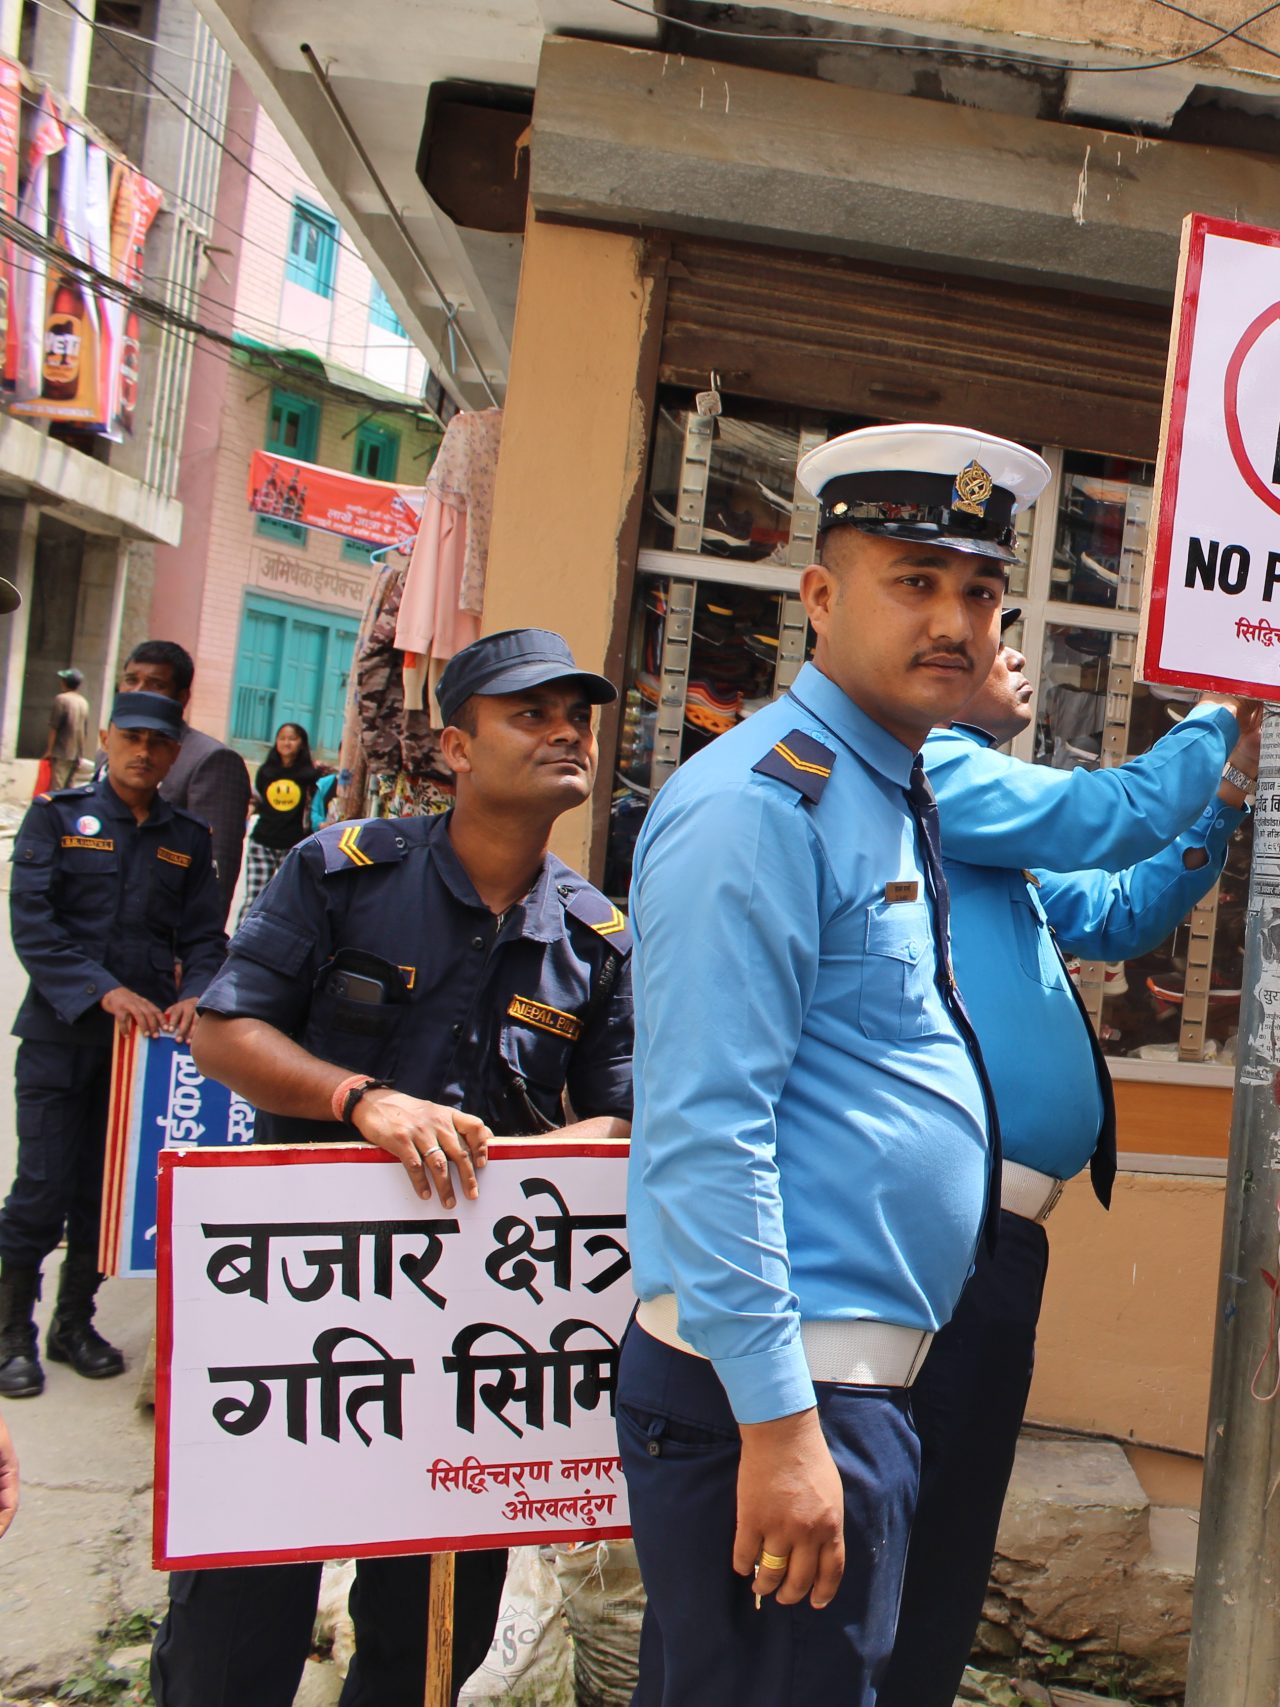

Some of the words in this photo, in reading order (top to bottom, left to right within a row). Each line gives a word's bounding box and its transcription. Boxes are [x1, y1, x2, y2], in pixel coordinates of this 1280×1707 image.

[1184, 537, 1250, 595] NO
[513, 1000, 553, 1025] NEPAL
[201, 1219, 460, 1310] बजार
[208, 1327, 415, 1446] गति
[426, 1456, 553, 1494] सिद्धिचरण
